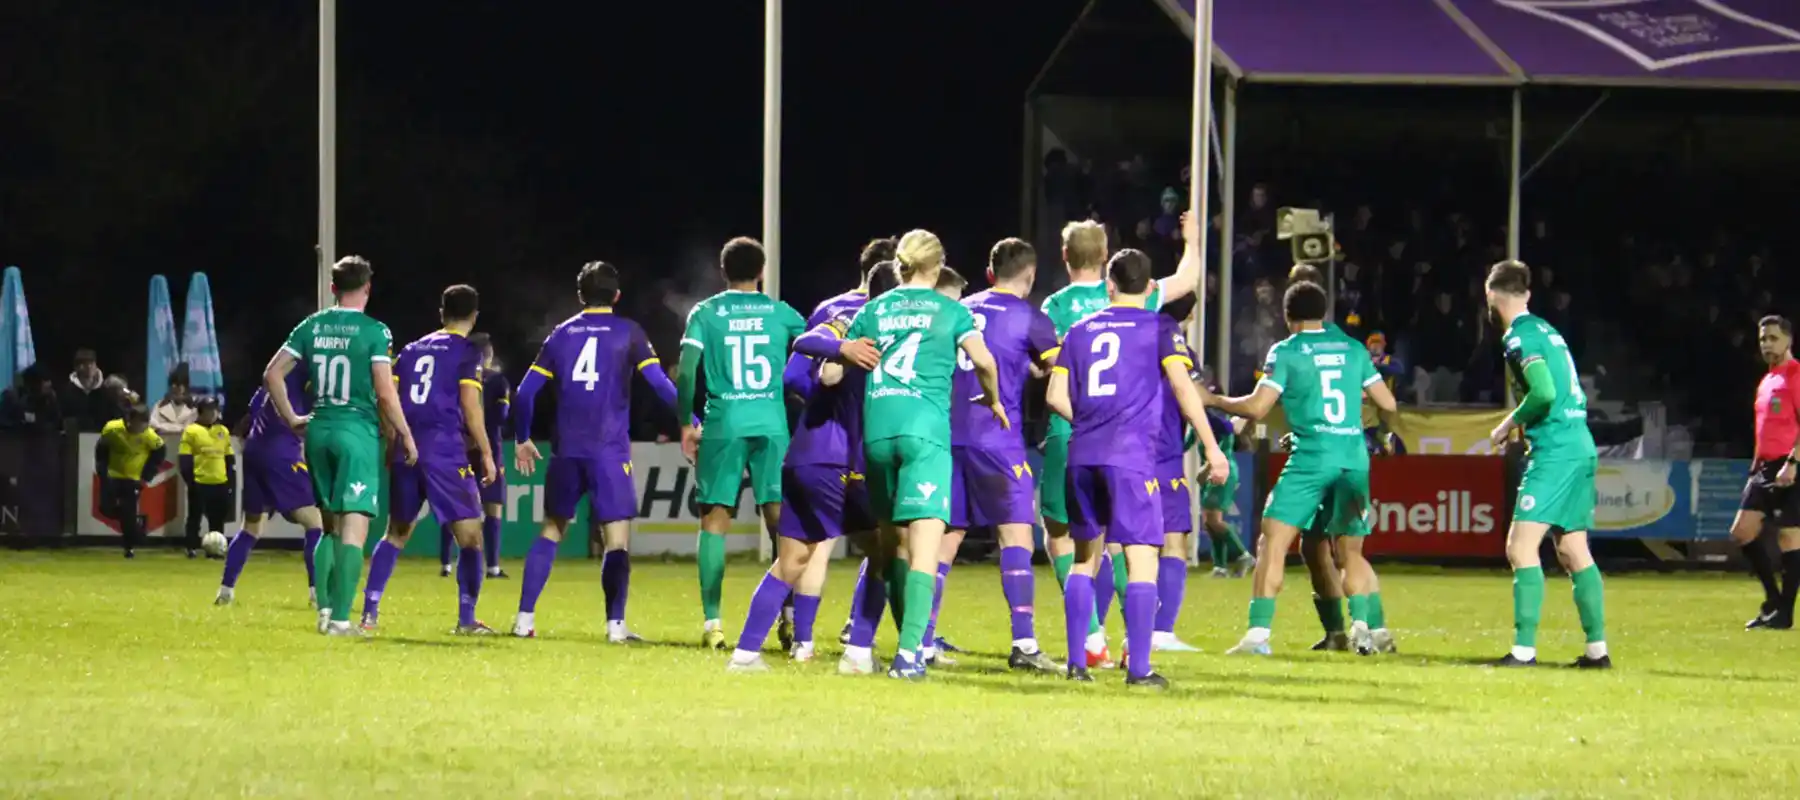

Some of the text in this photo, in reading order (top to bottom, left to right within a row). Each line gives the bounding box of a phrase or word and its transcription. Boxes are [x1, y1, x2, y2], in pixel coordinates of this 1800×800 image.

[313, 336, 351, 350] MURPHY
[572, 336, 599, 391] 4
[724, 335, 771, 390] 15
[1088, 332, 1120, 397] 2
[312, 354, 351, 406] 10
[410, 355, 435, 404] 3
[1321, 370, 1346, 424] 5
